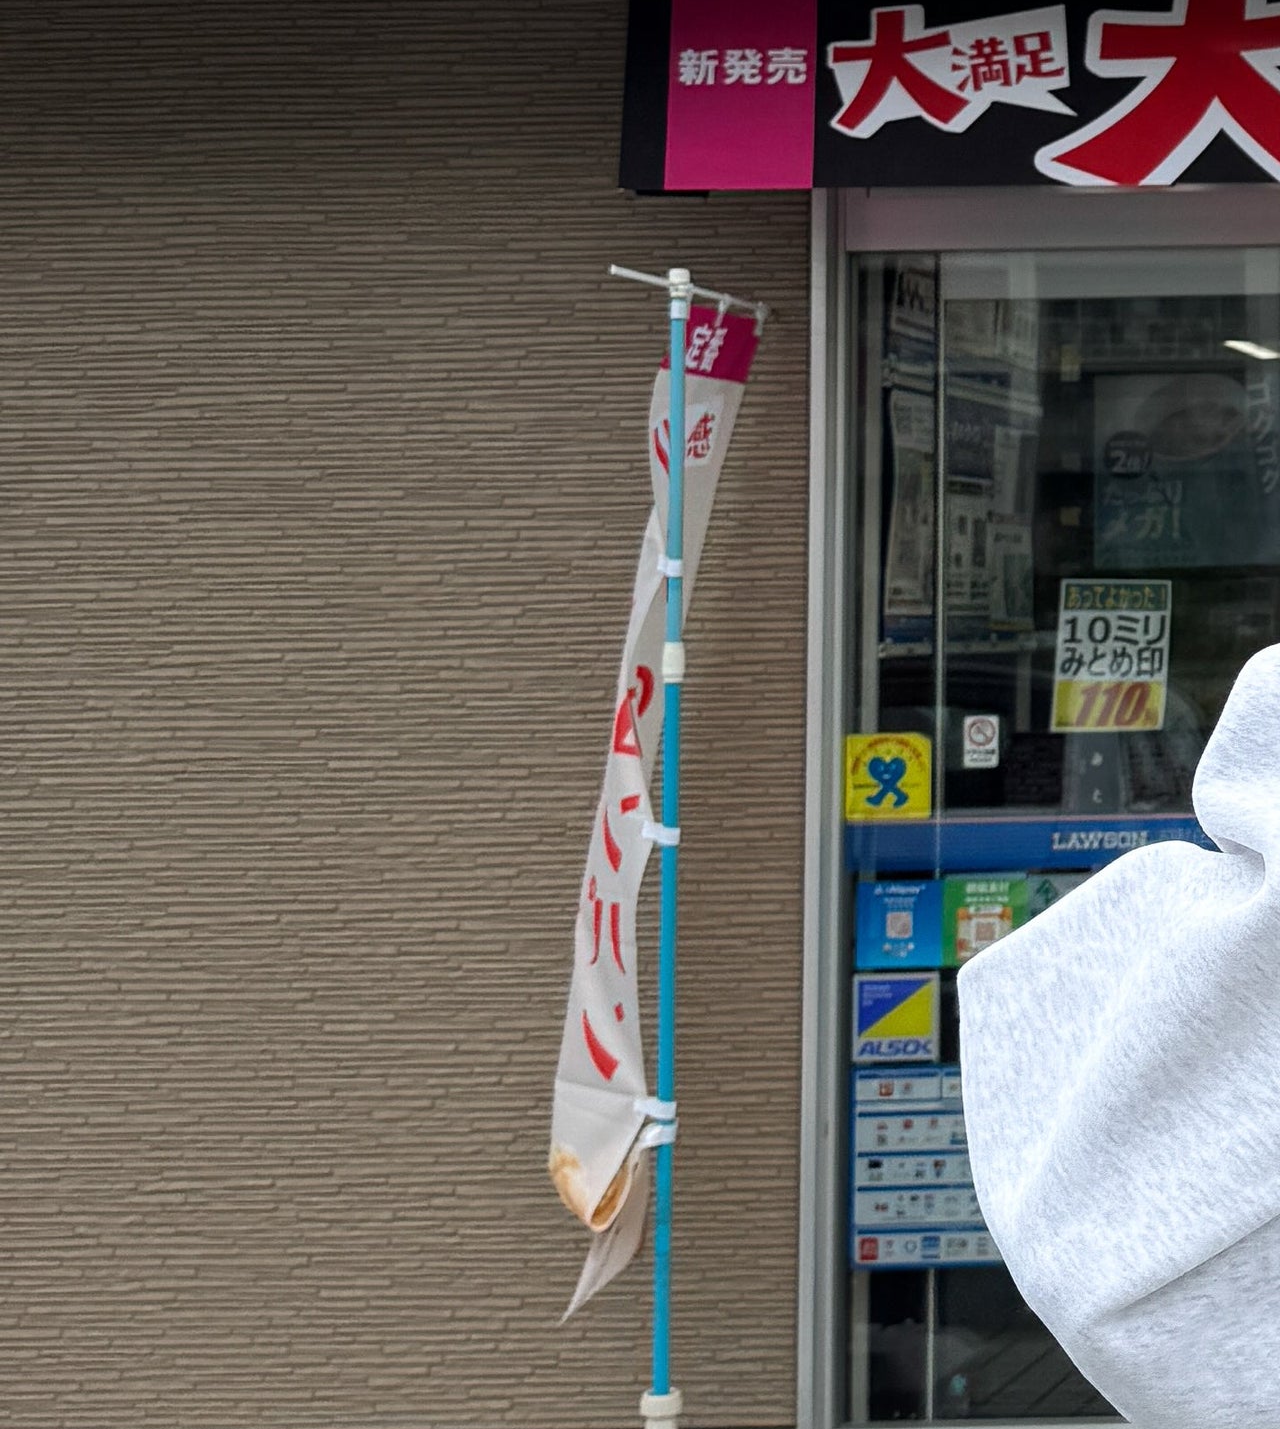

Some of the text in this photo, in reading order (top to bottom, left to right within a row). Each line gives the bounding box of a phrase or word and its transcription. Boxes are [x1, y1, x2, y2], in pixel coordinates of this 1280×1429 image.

[677, 45, 809, 86] 新発売
[830, 5, 1068, 132] 大満足
[1063, 614, 1167, 646] 10ミリ
[1060, 646, 1164, 678] みとめ印
[1075, 681, 1151, 727] 110
[1052, 829, 1149, 851] LAWSON
[857, 1039, 934, 1057] ALSOK
